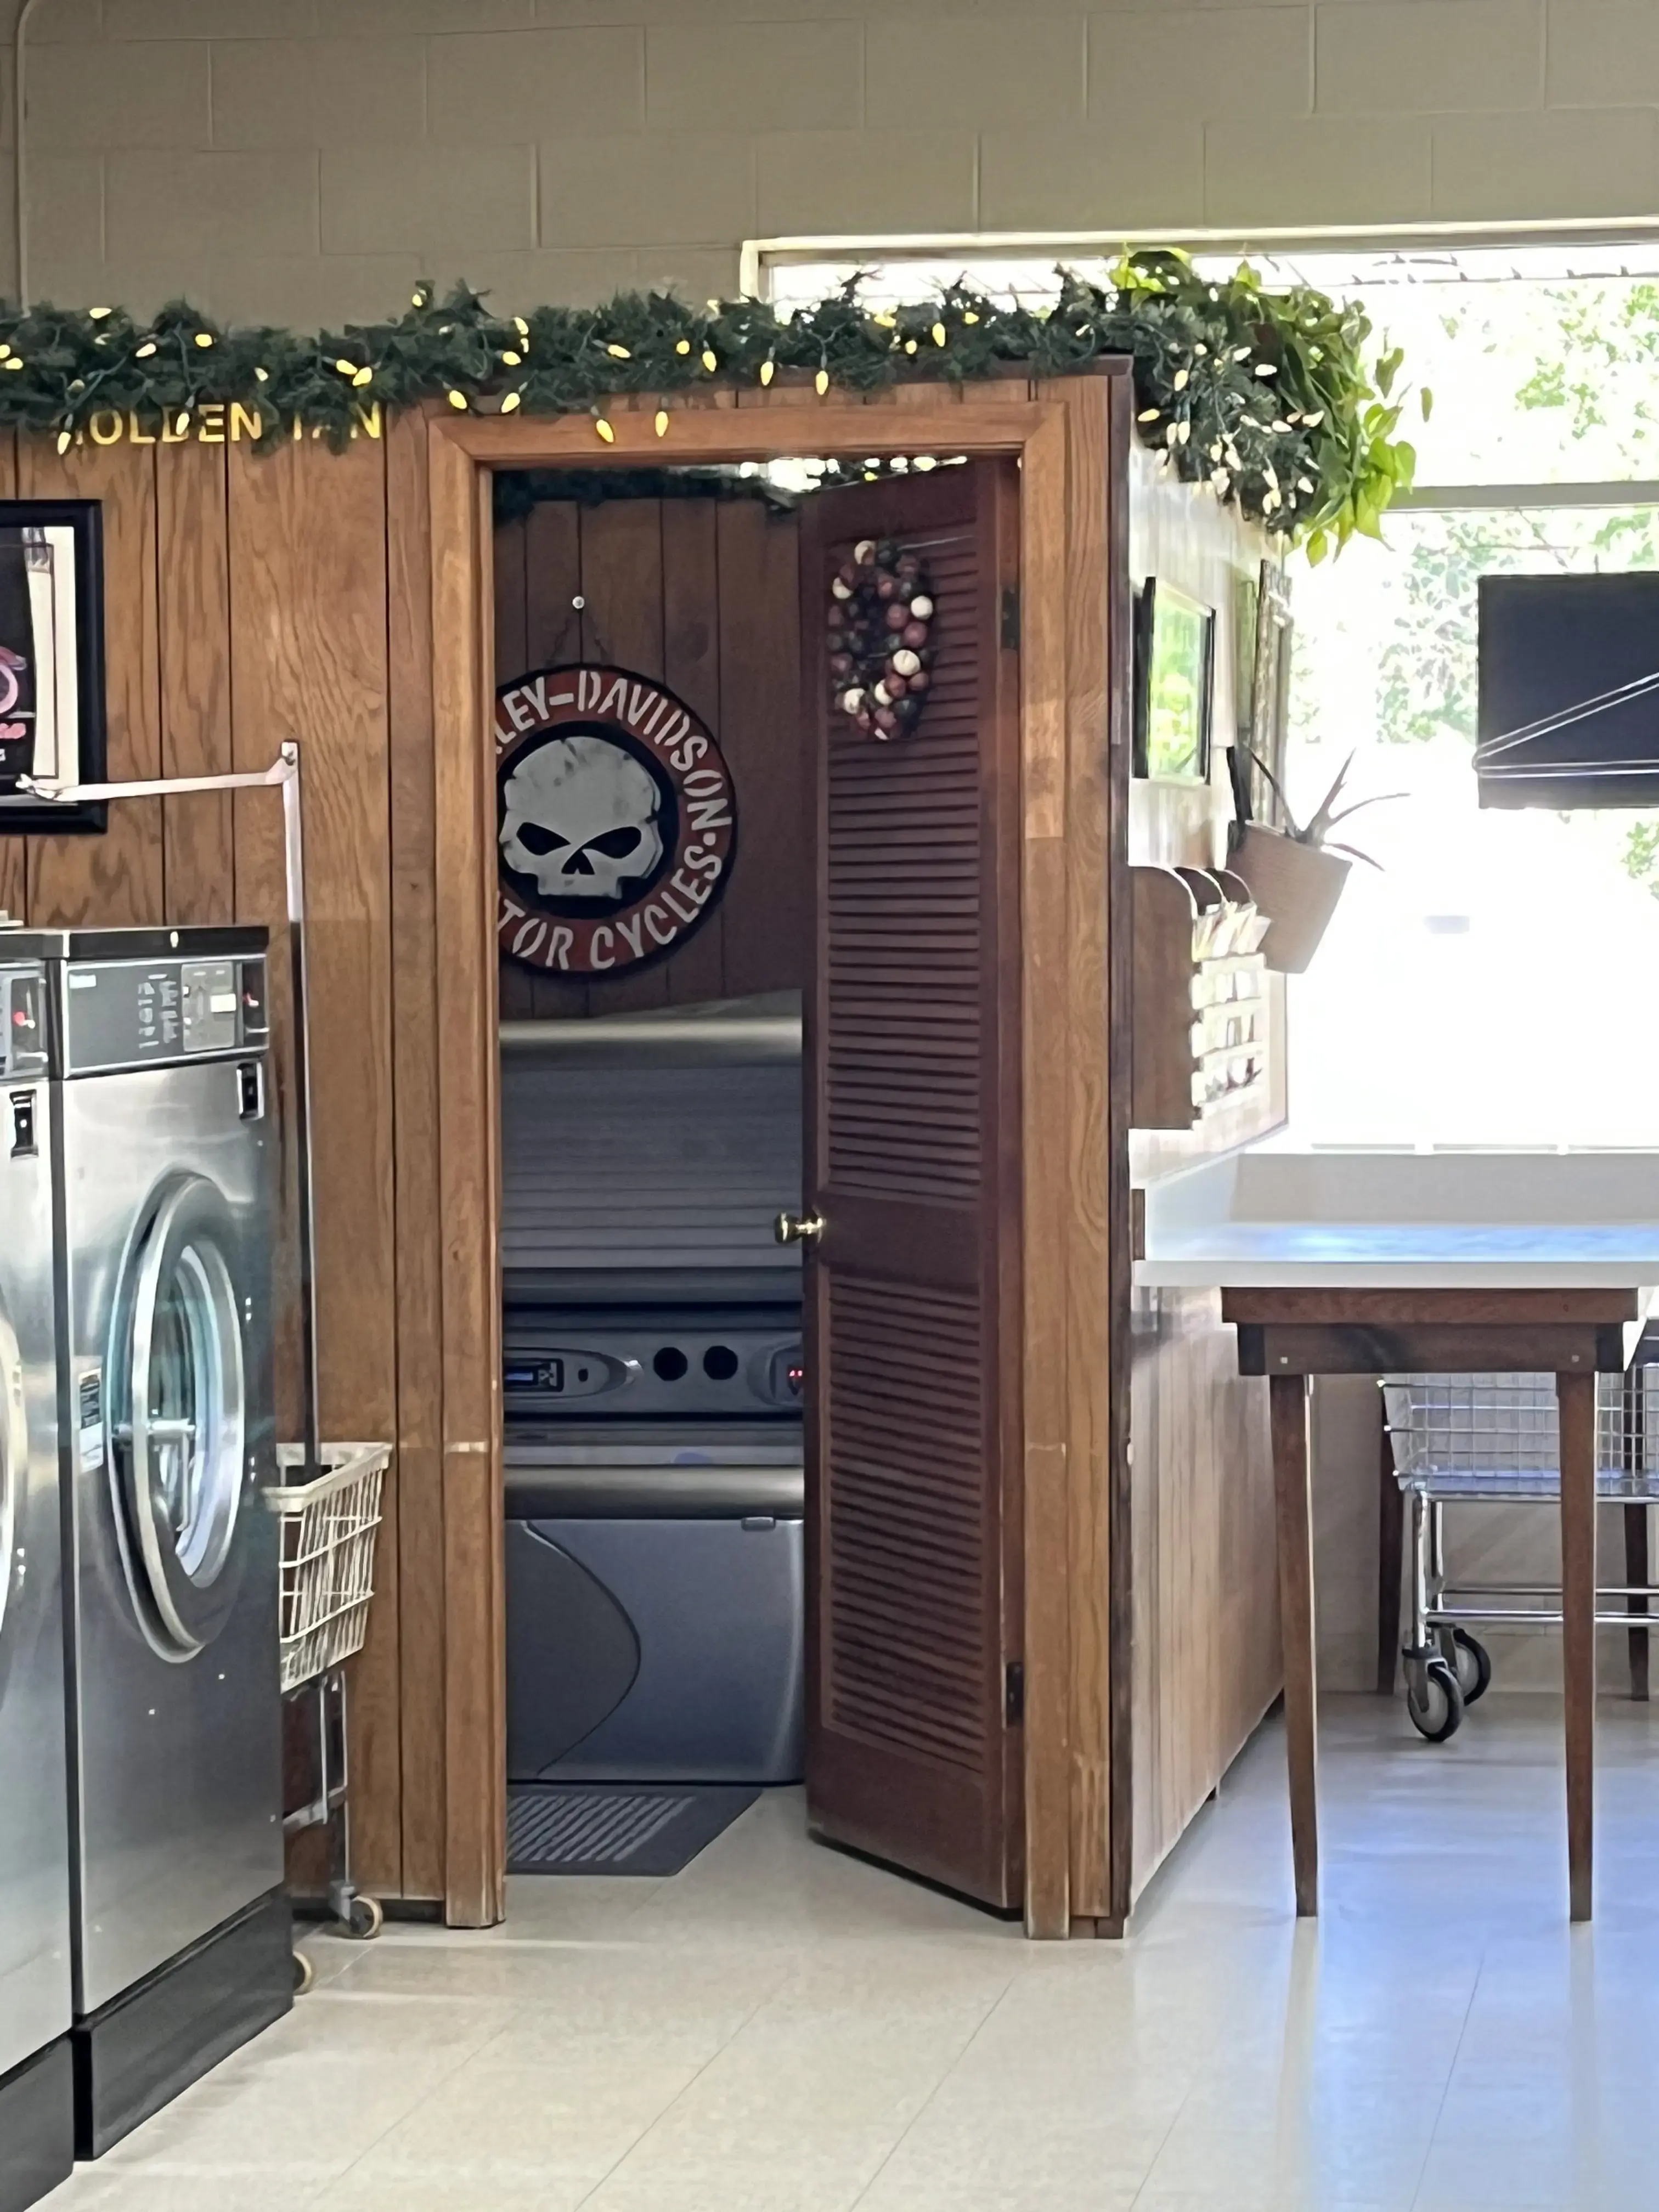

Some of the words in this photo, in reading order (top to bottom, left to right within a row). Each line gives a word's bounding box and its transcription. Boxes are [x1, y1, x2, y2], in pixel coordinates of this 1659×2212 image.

[76, 402, 263, 445] OLDEN
[495, 670, 733, 830] LEY-DAVIDSON
[496, 891, 574, 970] TOR
[590, 845, 722, 969] CYCLES
